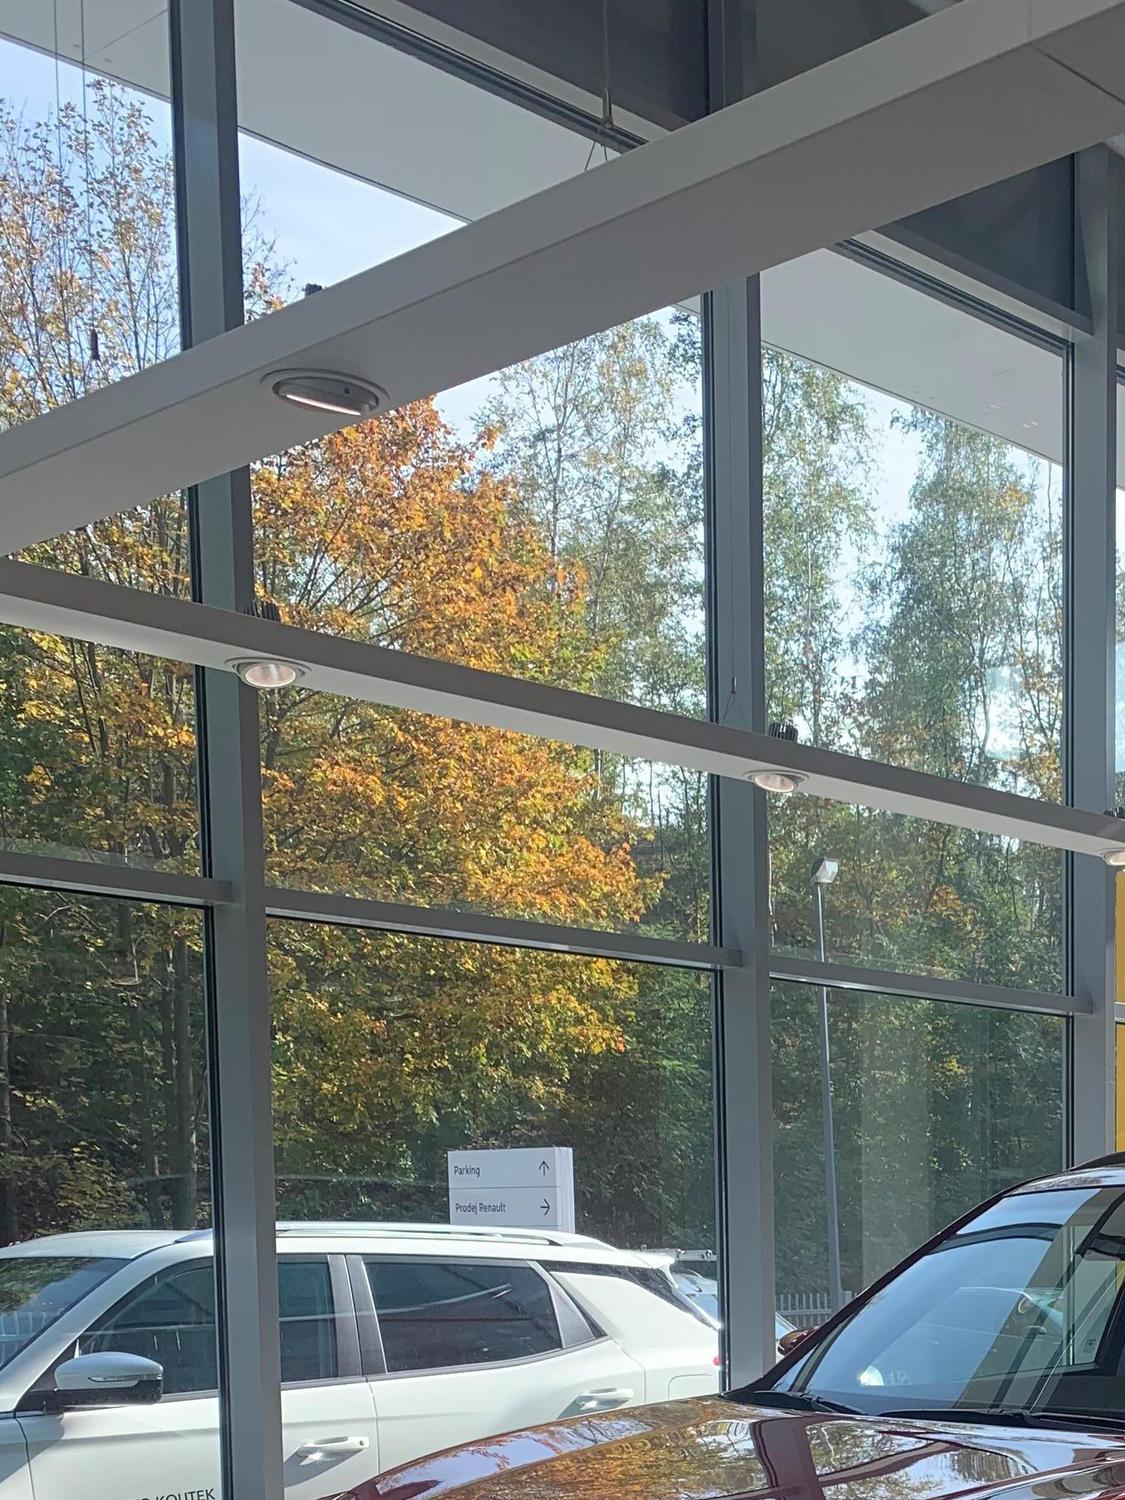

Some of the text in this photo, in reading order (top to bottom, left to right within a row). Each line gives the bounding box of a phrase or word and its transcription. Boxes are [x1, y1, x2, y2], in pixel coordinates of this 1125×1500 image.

[453, 1165, 481, 1177] Parking
[455, 1202, 506, 1214] Prodej Renault
